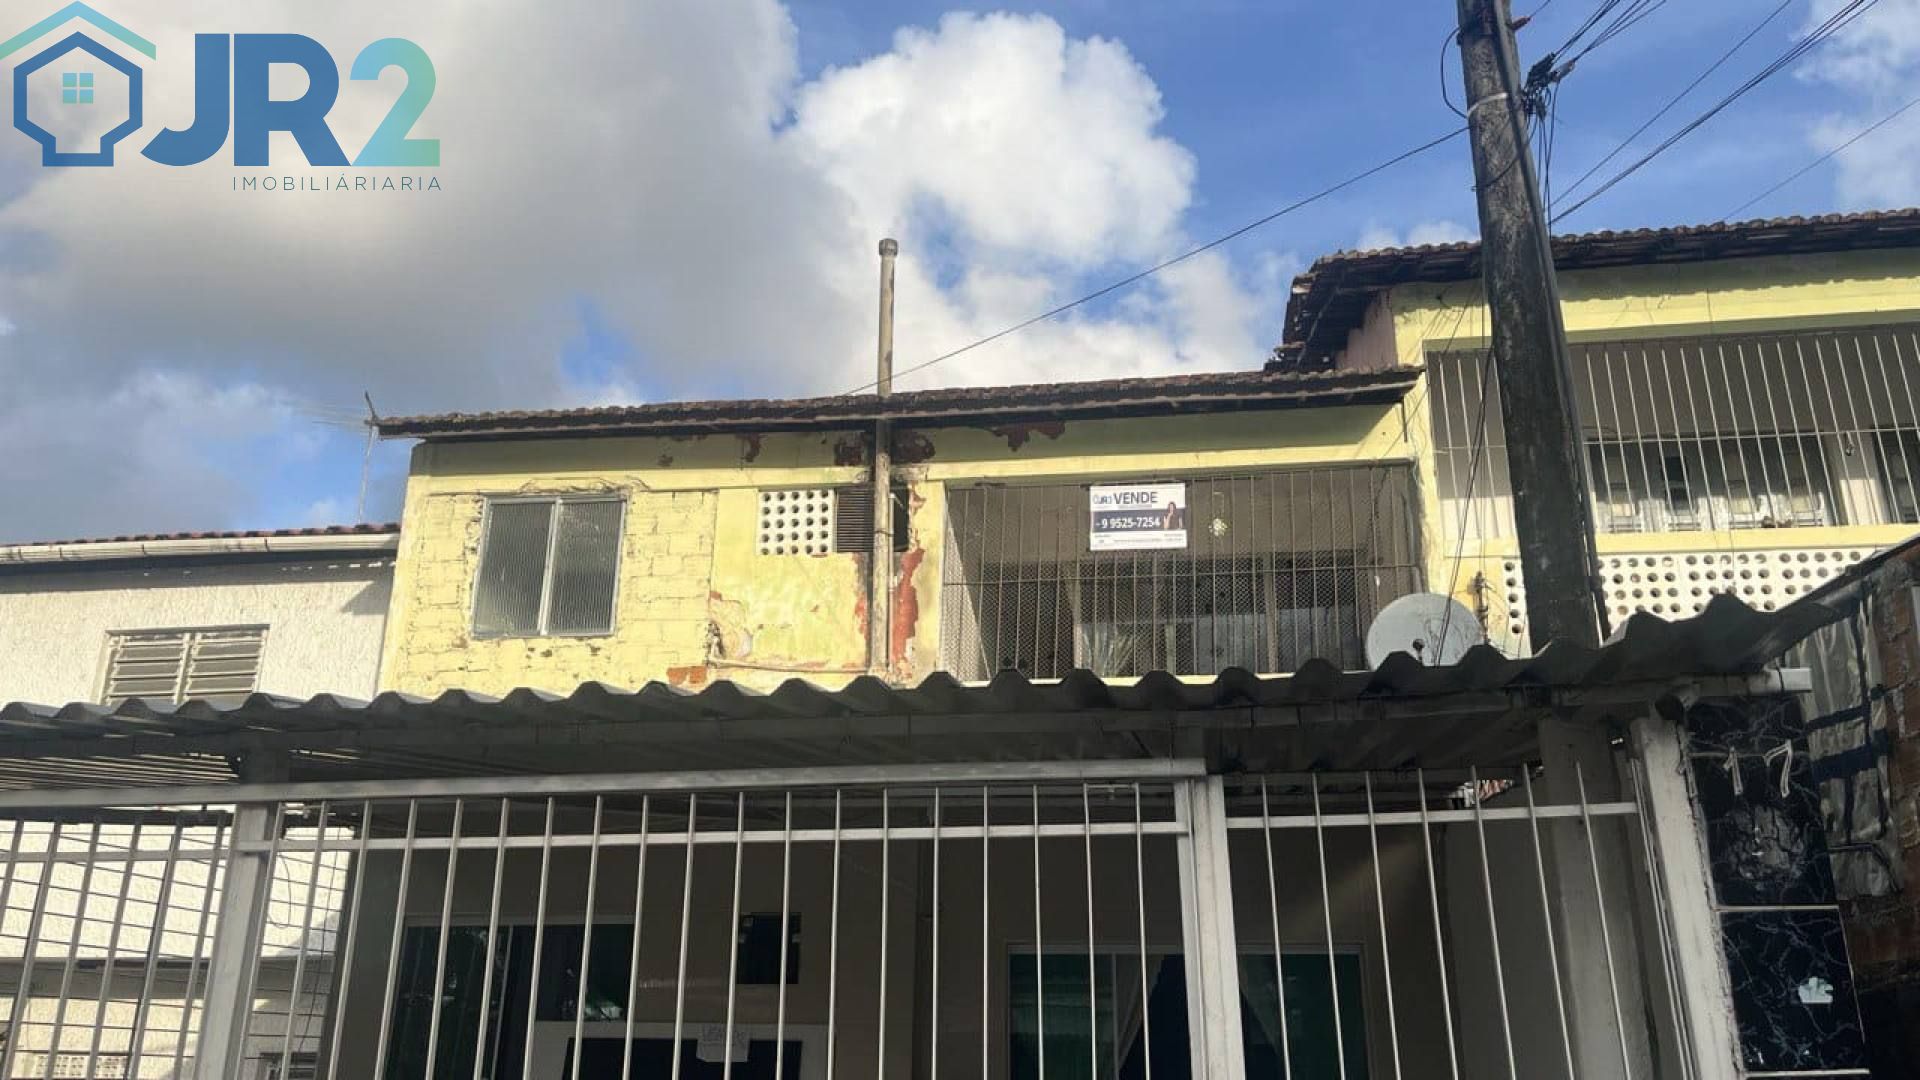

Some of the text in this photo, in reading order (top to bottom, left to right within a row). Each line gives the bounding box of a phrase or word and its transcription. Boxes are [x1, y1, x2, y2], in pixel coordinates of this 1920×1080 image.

[1113, 491, 1158, 505] VENDE
[1101, 516, 1161, 529] 9 9525-7254
